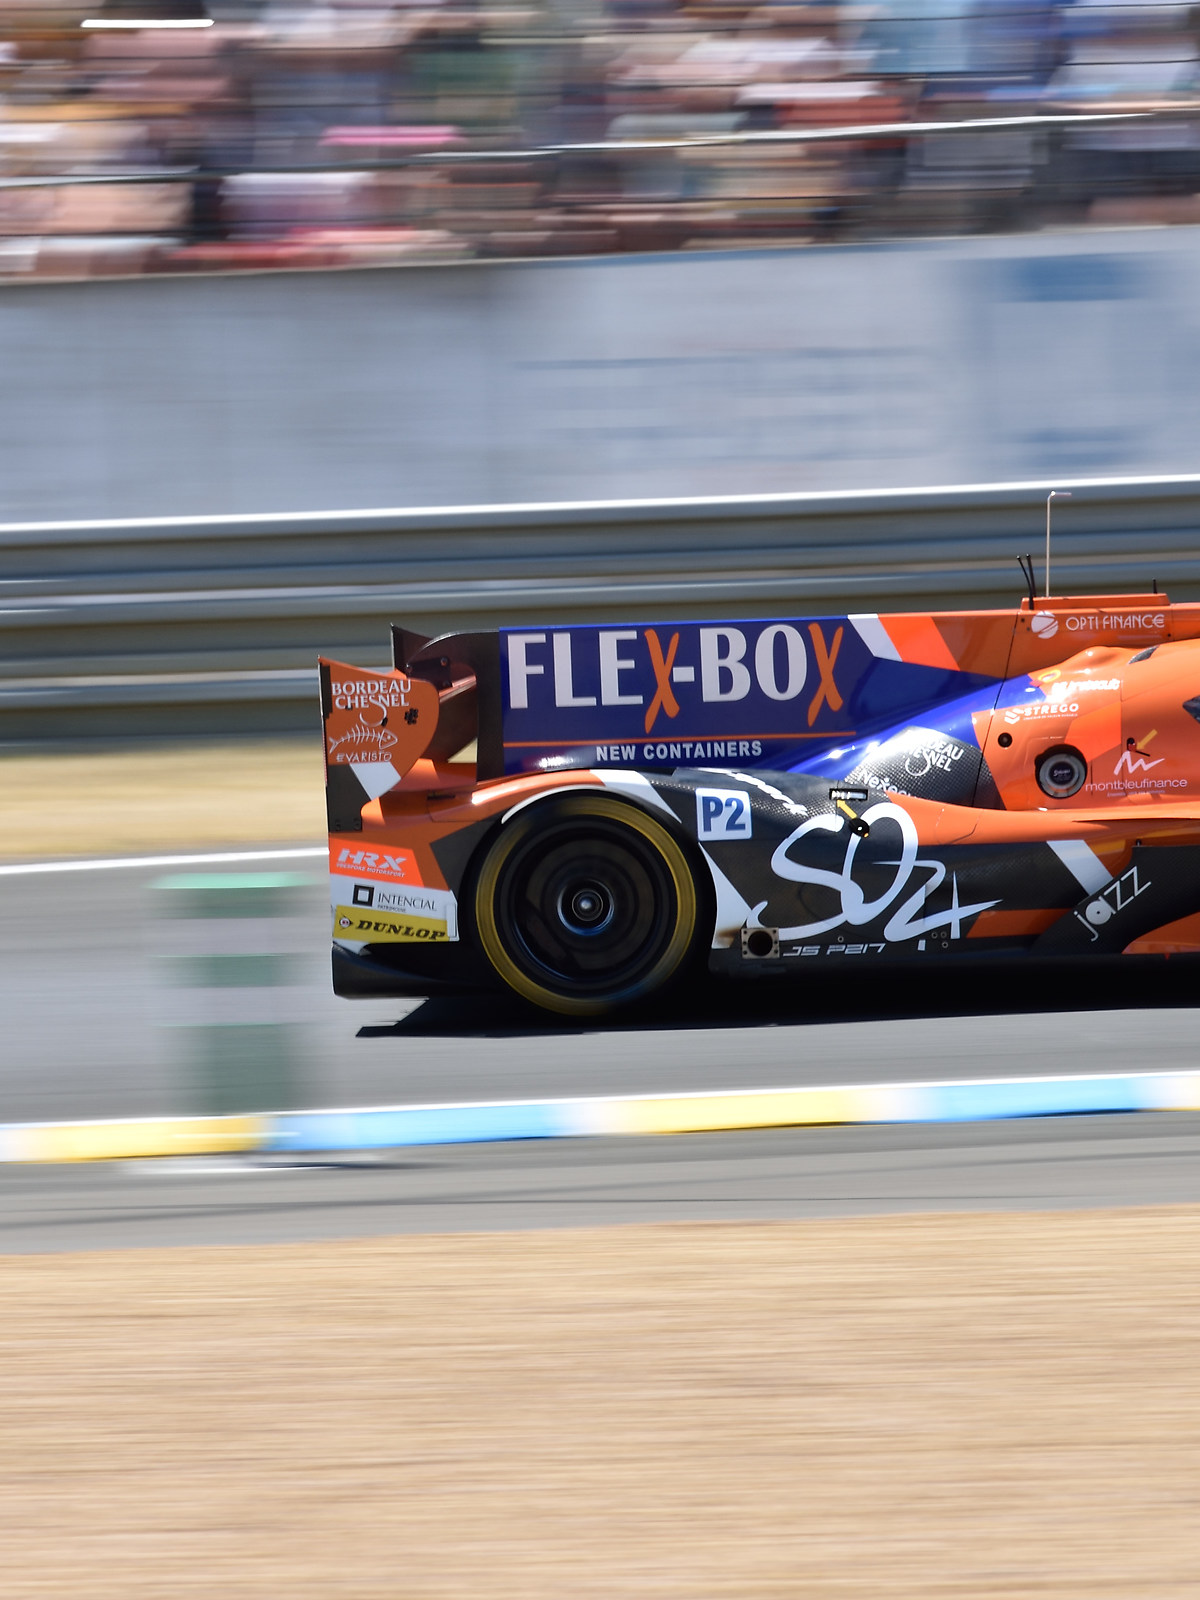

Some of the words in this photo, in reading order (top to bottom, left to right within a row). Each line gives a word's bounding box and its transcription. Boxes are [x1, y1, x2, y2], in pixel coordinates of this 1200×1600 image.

[1066, 617, 1099, 631] OPTI
[331, 679, 411, 696] BORDEAU
[507, 623, 844, 734] FLEX-BOX
[335, 693, 409, 727] CHESNEL
[1023, 703, 1079, 716] STREGO
[596, 745, 637, 762] NEW
[643, 740, 762, 761] CONTAINERS
[1085, 778, 1188, 791] montbleufinance
[702, 796, 746, 832] P2
[338, 848, 407, 872] HRX
[378, 893, 437, 912] INTENCIAL
[1073, 866, 1152, 942] jazz
[355, 919, 446, 940] DUNLOP
[826, 943, 887, 956] P217
